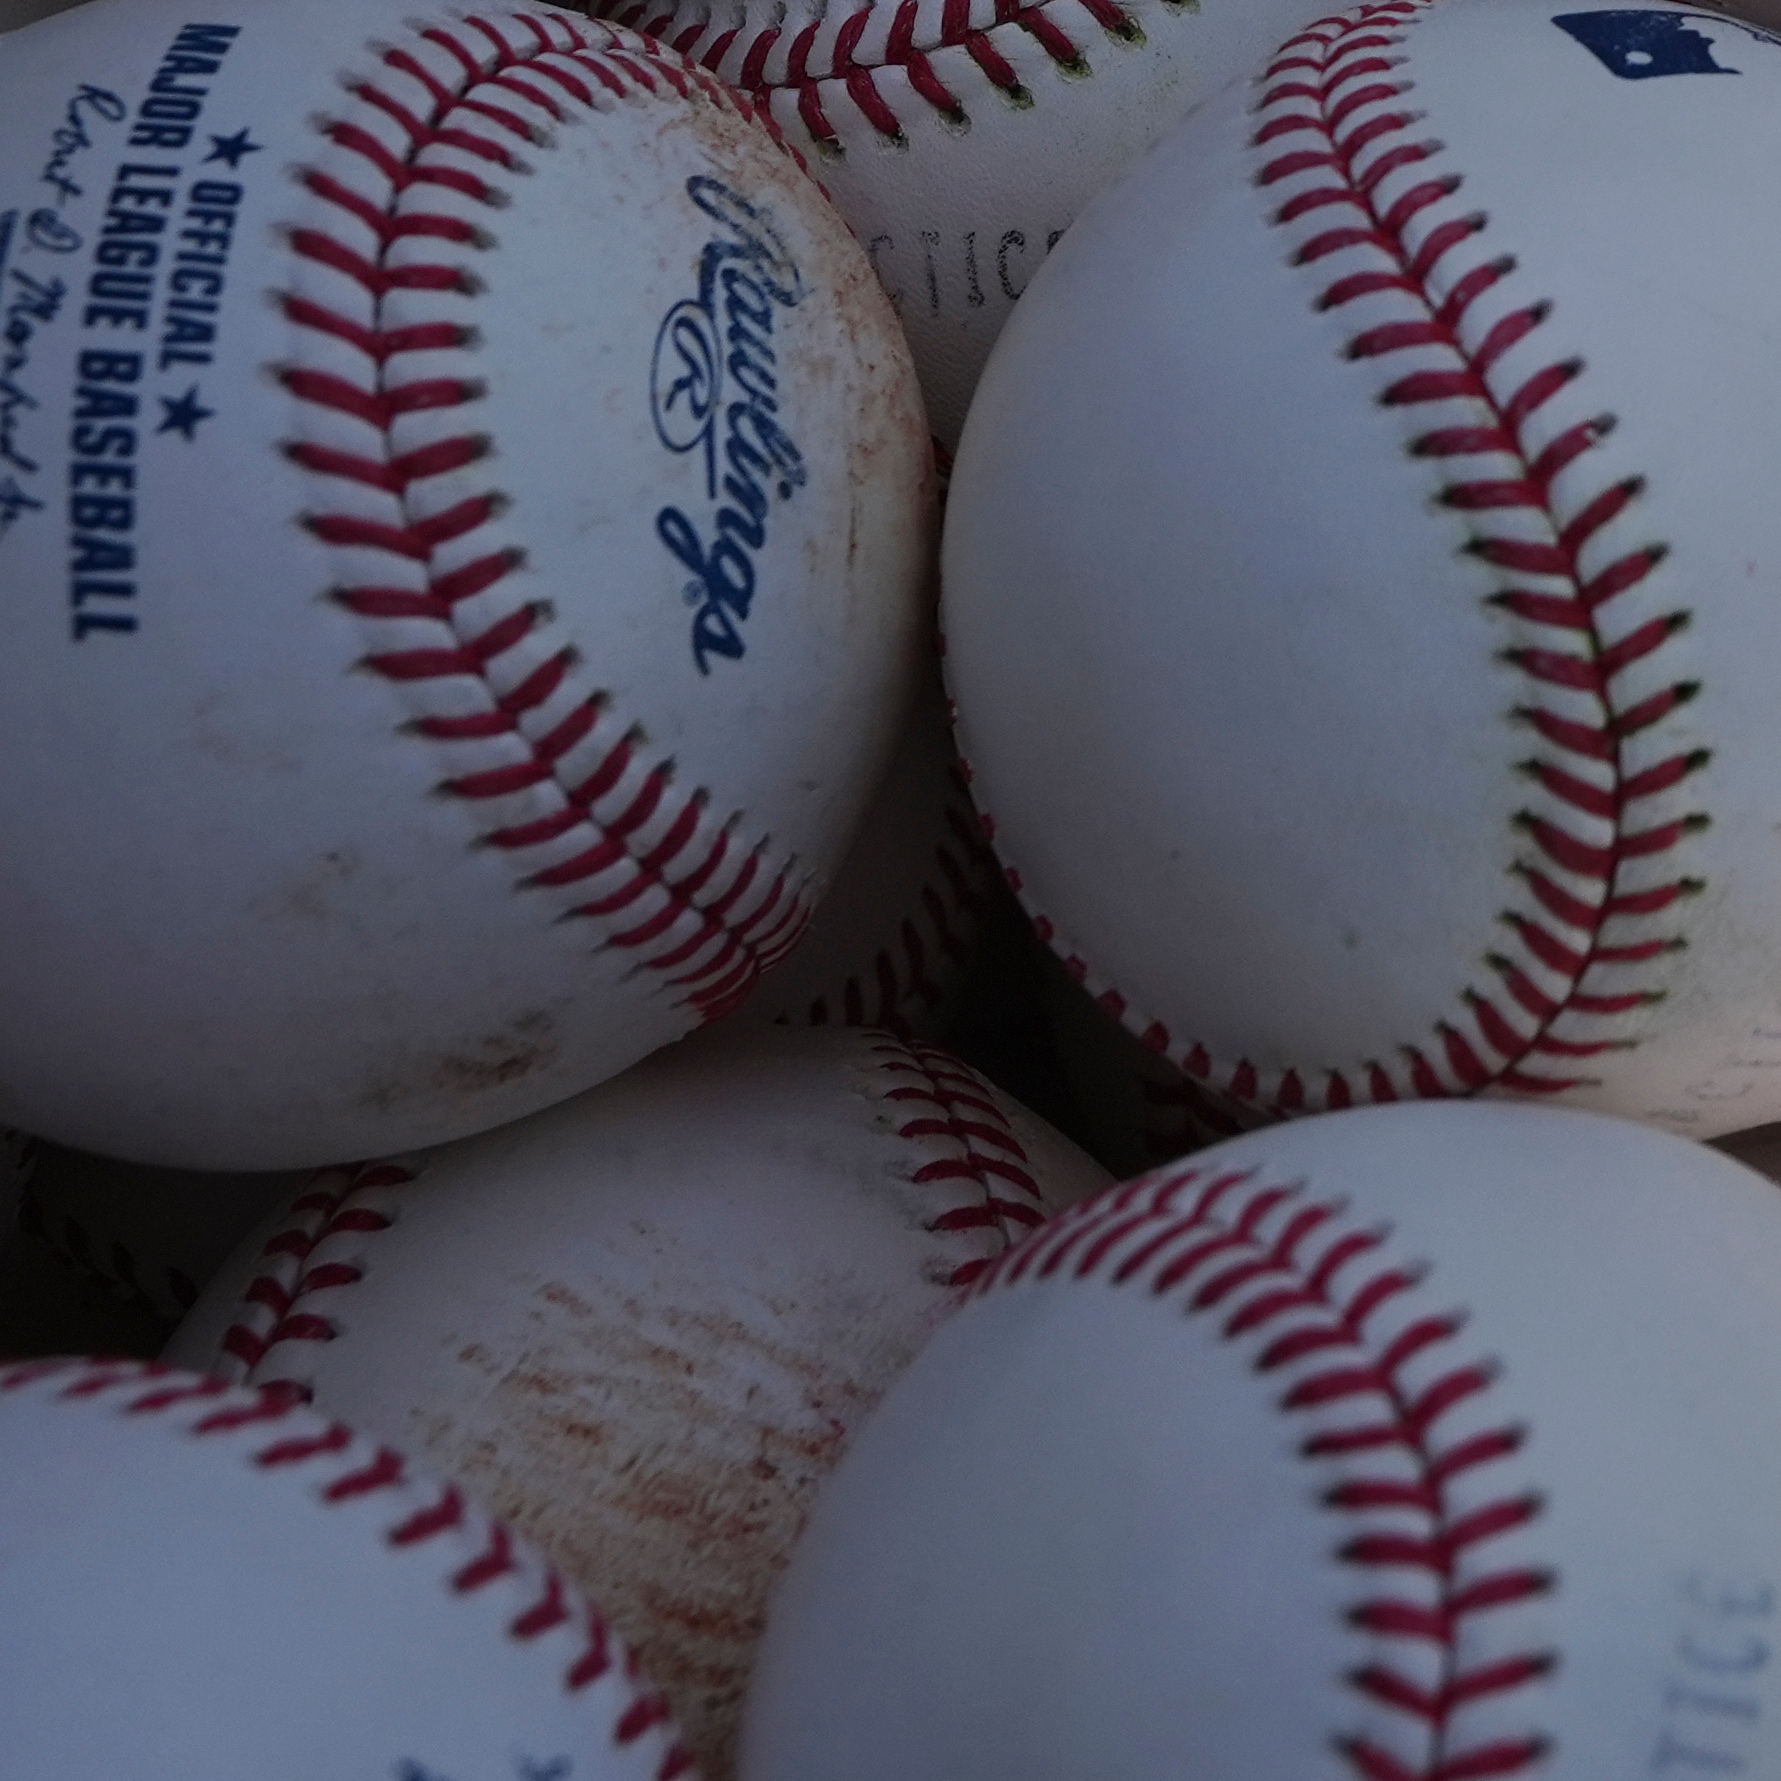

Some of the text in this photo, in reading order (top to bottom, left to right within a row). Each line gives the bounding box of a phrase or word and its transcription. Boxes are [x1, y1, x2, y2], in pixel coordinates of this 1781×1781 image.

[68, 23, 243, 643] MAJOR LEAGUE BASEBALL
[157, 180, 244, 372] OFFICIAL
[652, 174, 810, 677] Rawlings
